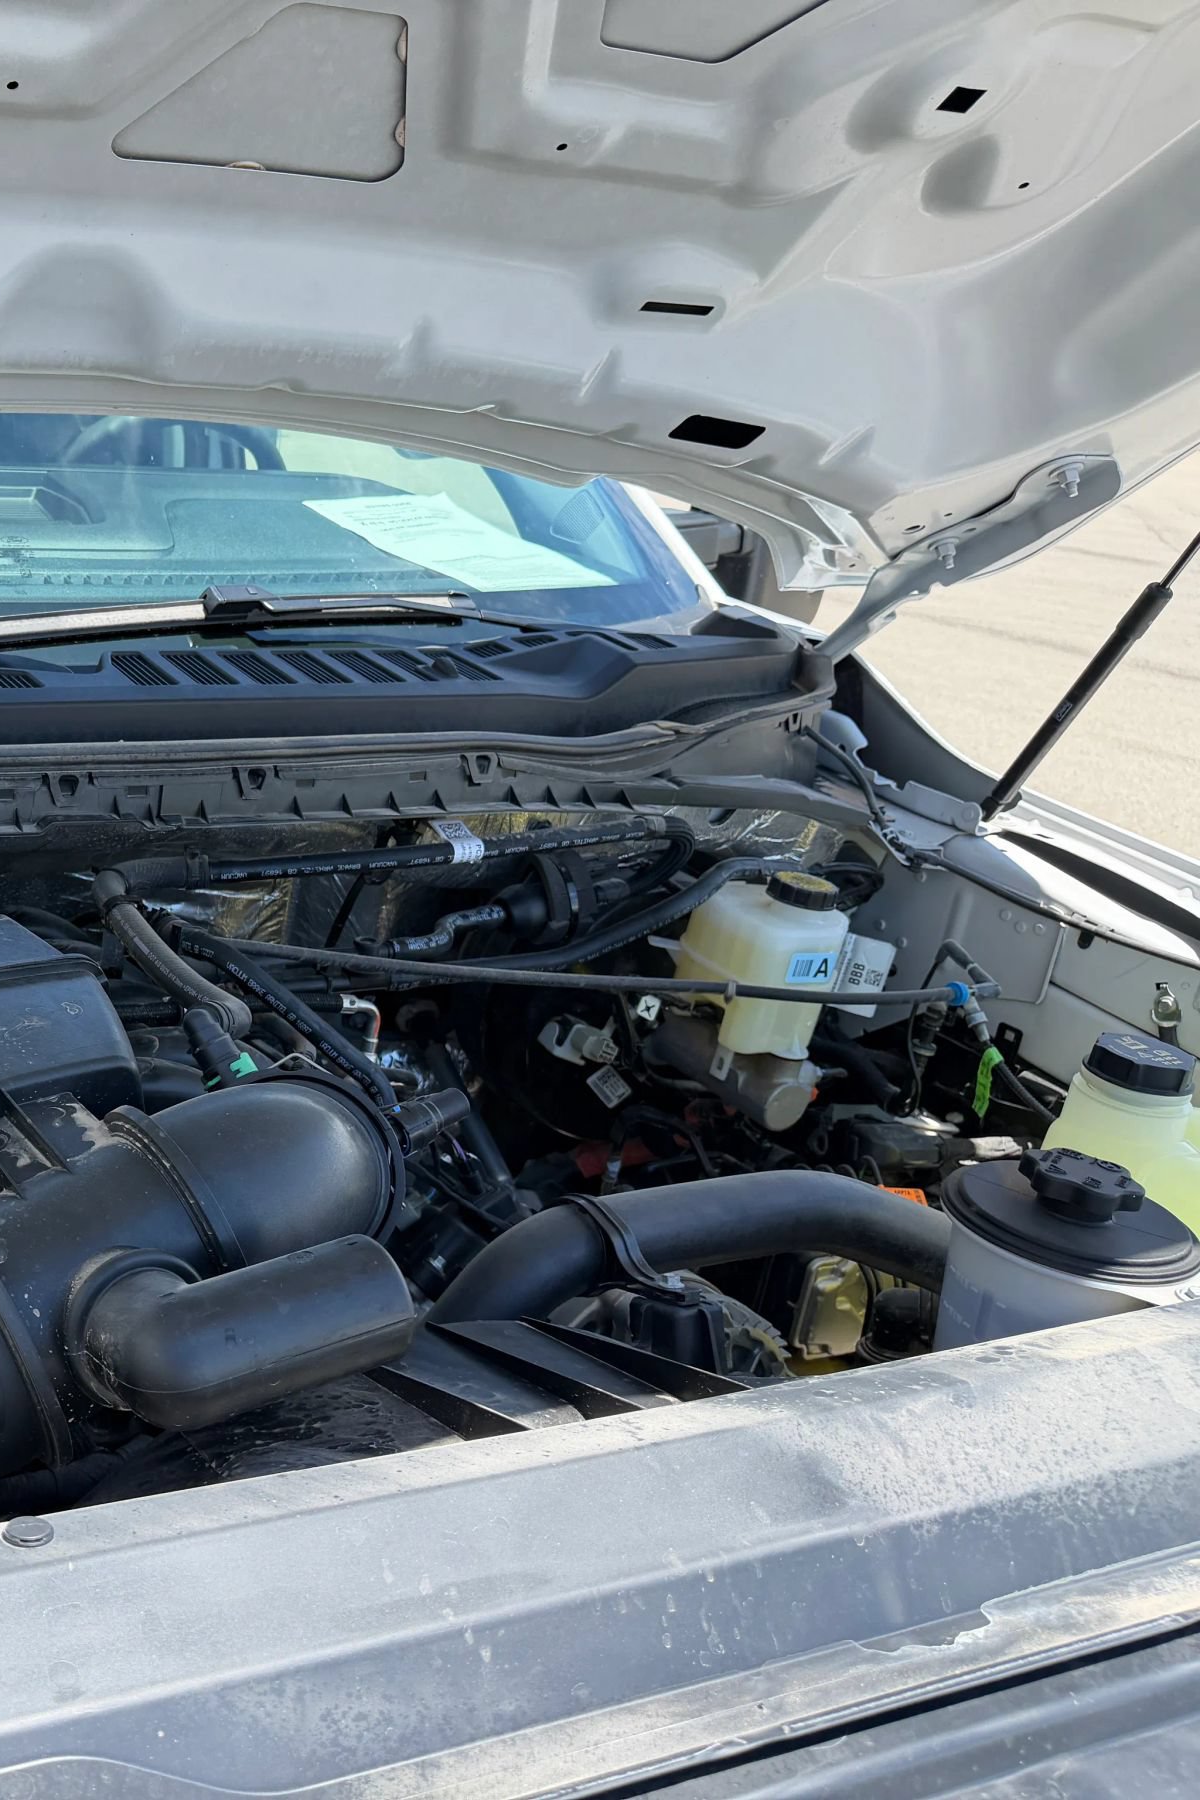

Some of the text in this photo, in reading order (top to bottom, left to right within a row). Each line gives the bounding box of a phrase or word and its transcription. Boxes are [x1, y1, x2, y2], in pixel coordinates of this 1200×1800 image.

[504, 845, 529, 854] VACUUM
[337, 863, 362, 872] BRAKE
[368, 860, 398, 869] VACUUM
[220, 872, 247, 880] VACUUM
[287, 868, 298, 876] GB
[813, 958, 829, 978] A
[848, 962, 865, 986] BBB
[225, 961, 248, 983] VACUUM
[247, 977, 266, 1000] BRAKE
[319, 1040, 339, 1061] VACUUM
[336, 1053, 354, 1072] BRAKE
